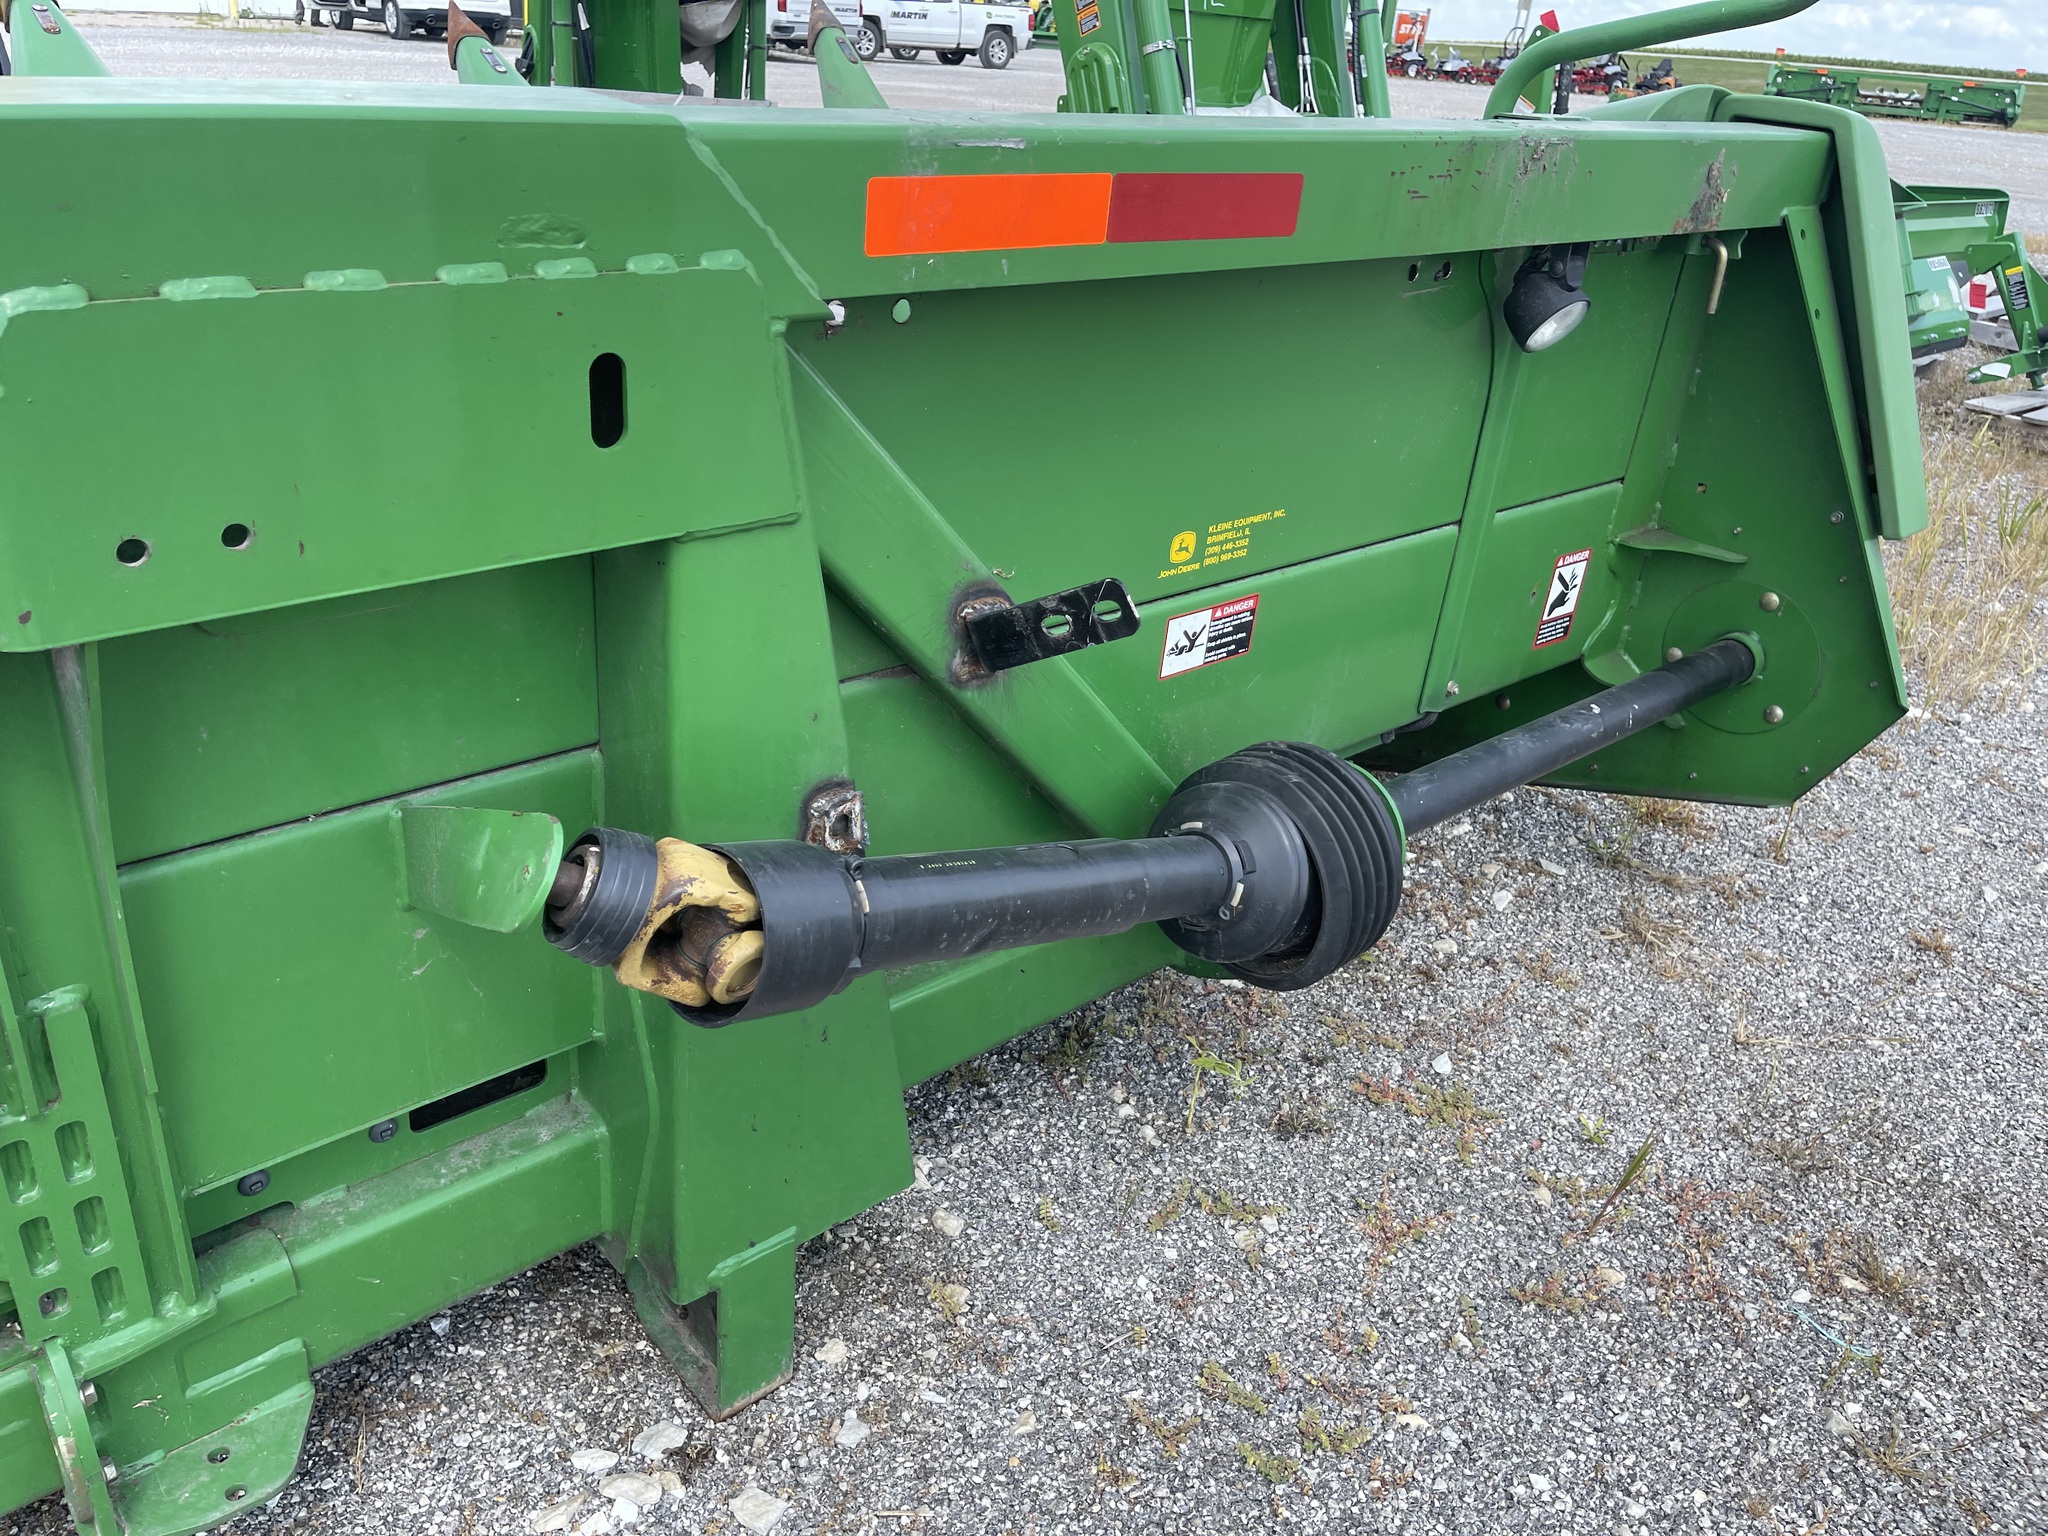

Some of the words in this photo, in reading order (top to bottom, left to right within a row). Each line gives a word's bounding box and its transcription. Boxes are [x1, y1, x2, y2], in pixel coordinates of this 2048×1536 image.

[892, 11, 928, 20] MARTIN
[1208, 521, 1232, 534] KLEINE
[1234, 512, 1273, 528] EQUIPMENT,
[1274, 509, 1286, 518] INC.
[1206, 530, 1243, 544] BRIMFIELD,
[1203, 556, 1219, 567] (800)
[1564, 550, 1590, 565] DANGER
[1158, 568, 1177, 579] JOHN
[1178, 563, 1200, 574] DEERE
[1223, 600, 1254, 615] DANGER
